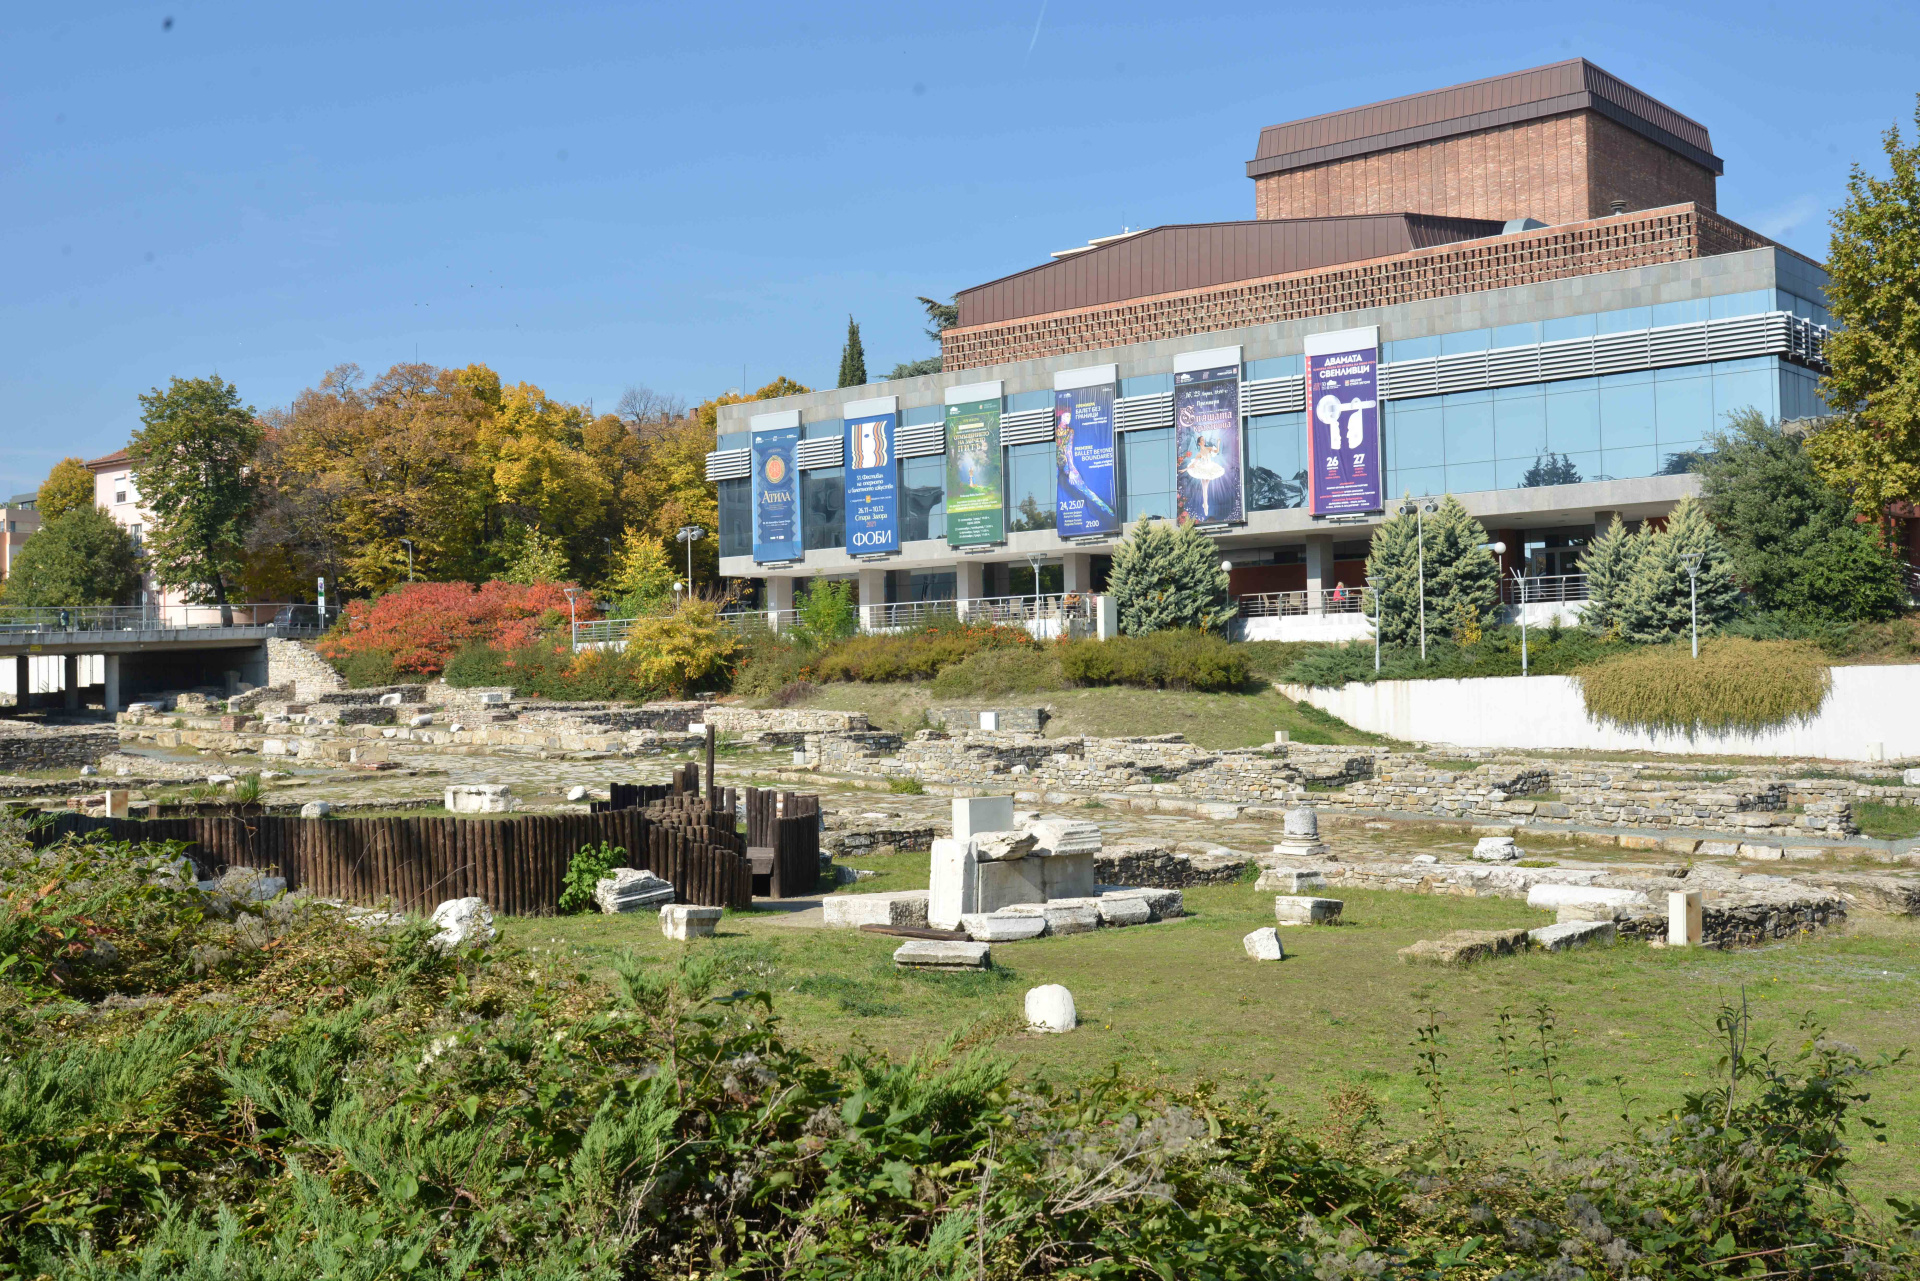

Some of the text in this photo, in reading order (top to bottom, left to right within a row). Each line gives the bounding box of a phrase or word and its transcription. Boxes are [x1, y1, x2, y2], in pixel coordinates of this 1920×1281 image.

[1324, 354, 1362, 366] ДВАМАТА
[1320, 365, 1370, 378] СВЕНЛИВЦИ
[1082, 453, 1112, 461] BOUNDARIES
[1327, 454, 1365, 467] 26 27
[1060, 500, 1084, 510] 24, 25.07
[853, 530, 891, 546] ФОБИ
